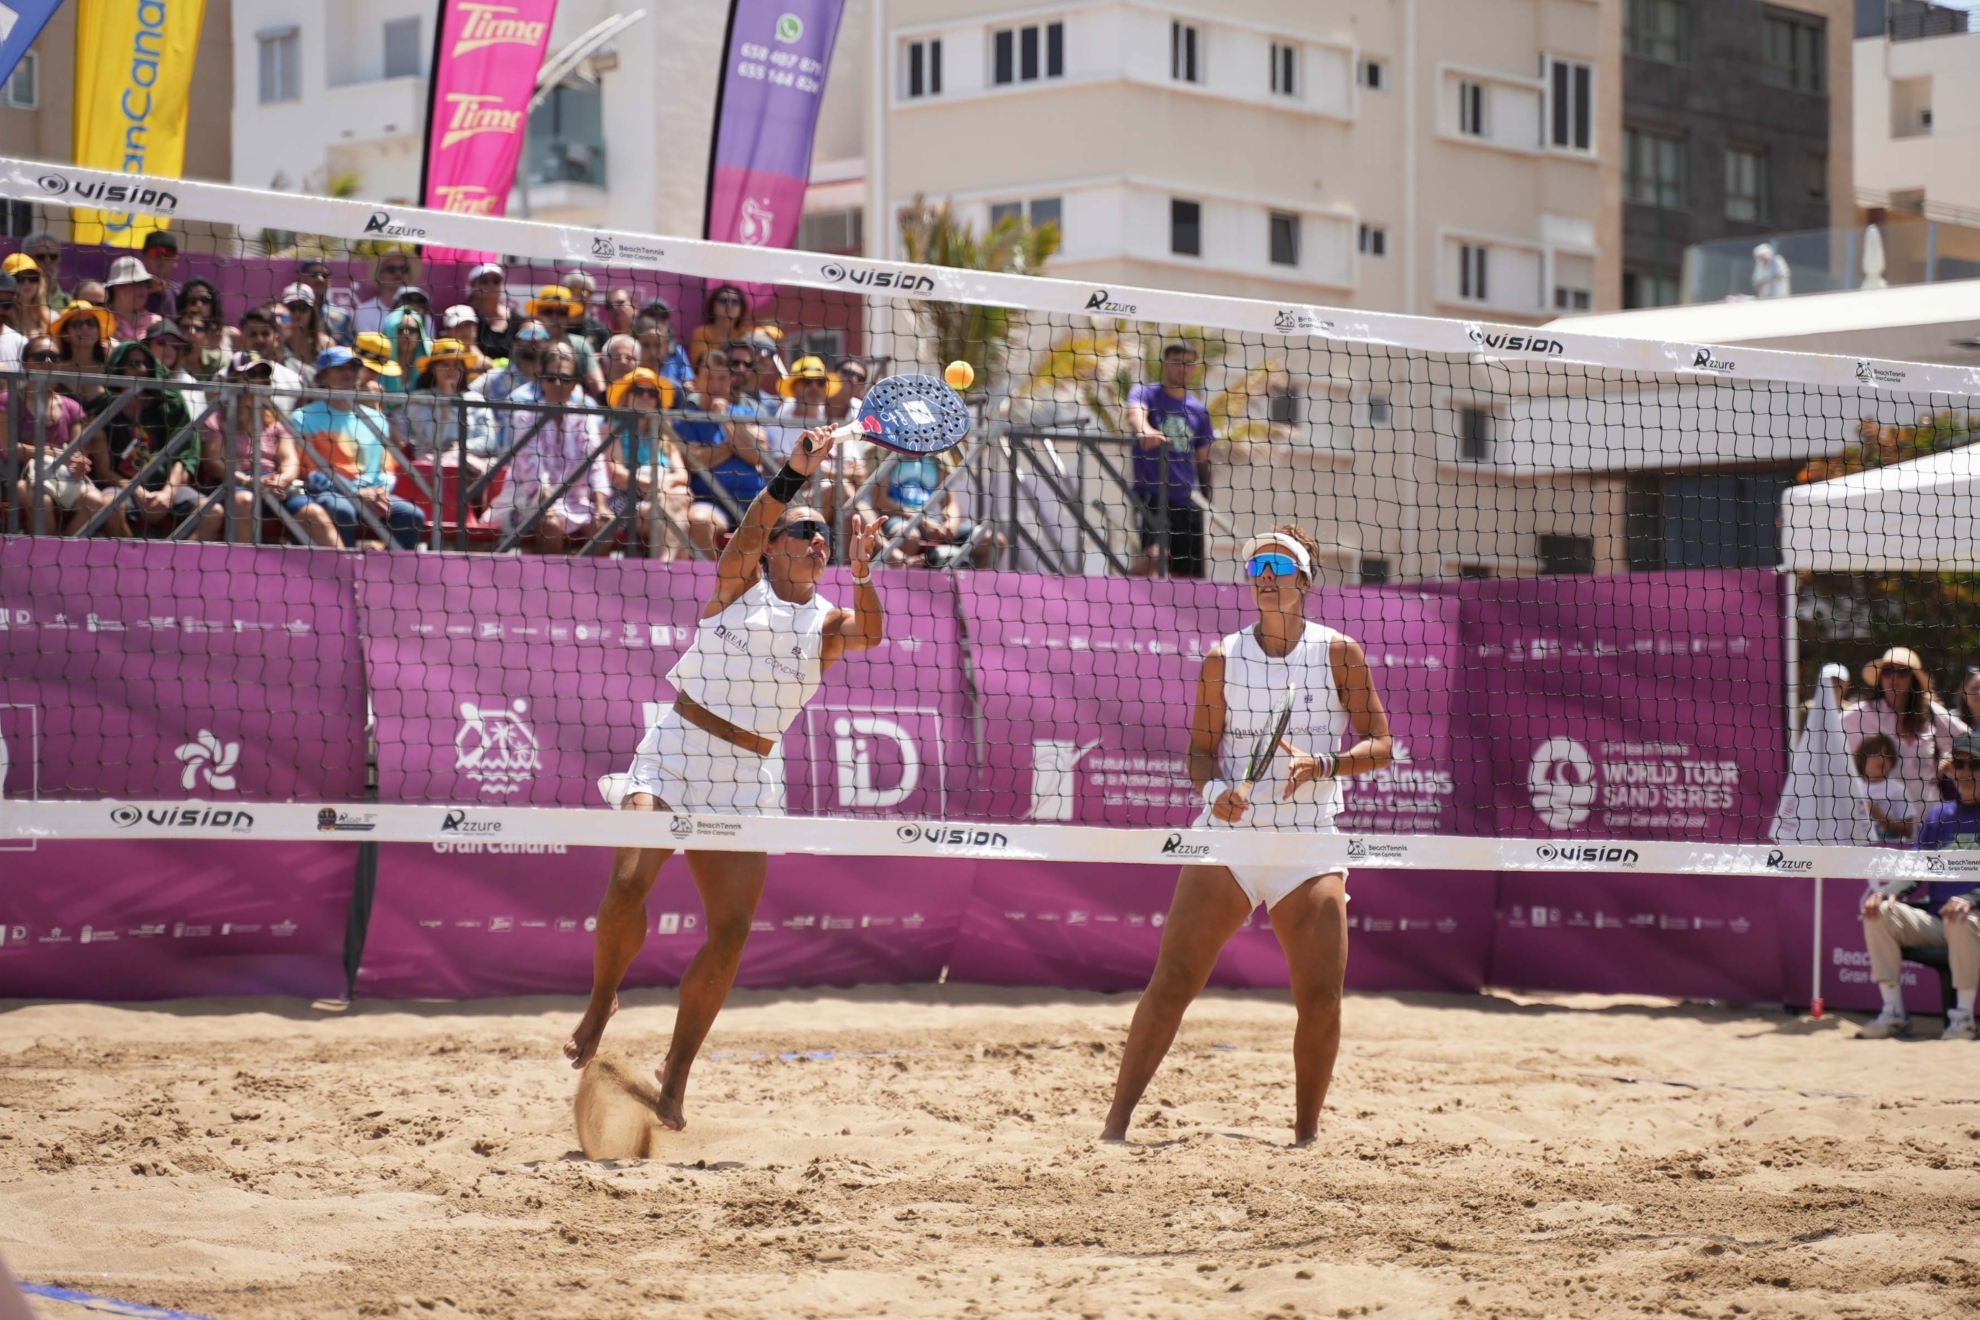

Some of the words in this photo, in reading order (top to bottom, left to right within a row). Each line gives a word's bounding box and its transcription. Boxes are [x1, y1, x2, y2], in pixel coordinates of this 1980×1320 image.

[452, 2, 546, 58] Tirma
[75, 182, 178, 209] vision
[155, 207, 175, 215] PRO
[363, 211, 426, 239] Azzure
[849, 268, 935, 291] vision
[1084, 289, 1137, 314] Azzure
[1485, 333, 1564, 354] vision
[1693, 348, 1735, 370] Azzure
[764, 657, 806, 681] CONDRES
[1602, 761, 1678, 784] WORLD
[1681, 762, 1739, 785] TOUR
[1602, 785, 1660, 808] SAND
[1663, 786, 1734, 809] SERIES
[147, 807, 254, 827] vision
[440, 809, 502, 832] Azzure
[925, 827, 1008, 847] vision
[1161, 833, 1210, 855] Azzure
[1560, 845, 1639, 863] vision
[1766, 849, 1813, 870] Azzure
